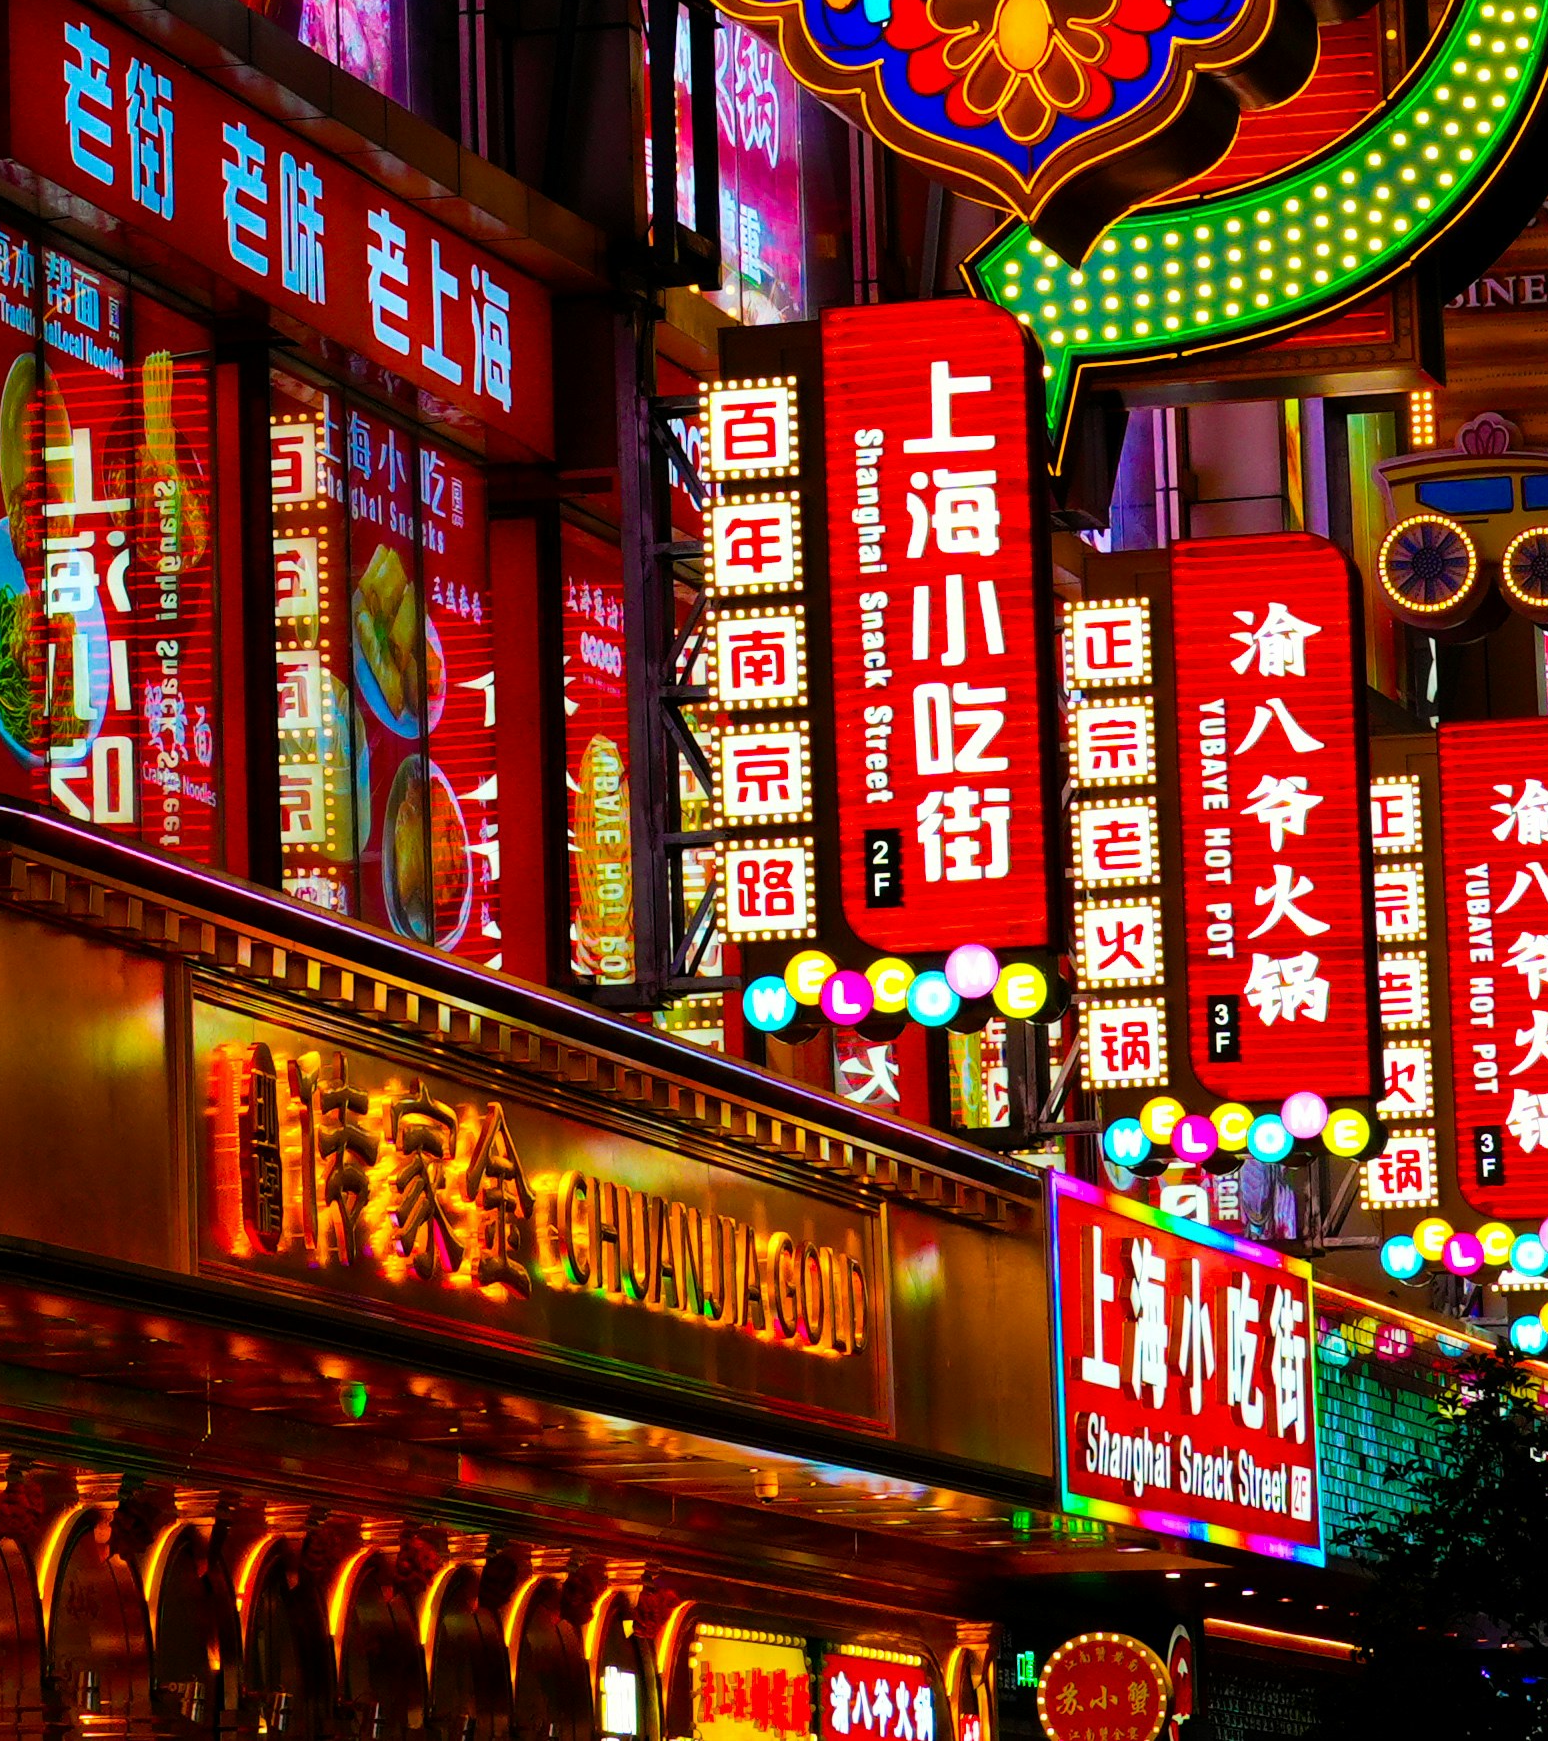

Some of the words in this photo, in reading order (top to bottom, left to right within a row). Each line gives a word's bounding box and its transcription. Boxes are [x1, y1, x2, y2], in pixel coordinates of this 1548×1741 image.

[63, 21, 175, 222] 老街
[221, 121, 326, 307] 老味
[366, 207, 512, 414] 老上海
[852, 427, 889, 575] Shanghai
[719, 400, 796, 919] 百年南京路
[858, 590, 893, 689] Snack
[902, 360, 1012, 883] 上海小吃街
[863, 705, 894, 804] Street
[1198, 698, 1230, 811] YUBAYE
[1084, 619, 1152, 1073] 正宗老火锅
[1203, 827, 1233, 885] HOT
[1228, 601, 1332, 1027] 渝八爷火锅
[871, 840, 892, 897] 2F
[1464, 862, 1495, 964] YUBAYE
[1205, 902, 1235, 960] POT
[750, 950, 1038, 1023] WELCOME
[1213, 1002, 1231, 1054] 3F
[1468, 976, 1496, 1029] HOT
[1471, 1043, 1499, 1094] POT
[1111, 1097, 1361, 1158] WELCOME
[1480, 1133, 1496, 1178] 3F
[1080, 1225, 1307, 1445] 上海小吃街
[1085, 1411, 1172, 1498] Shanghai
[1179, 1434, 1234, 1503] Snack
[1237, 1448, 1288, 1514] Street
